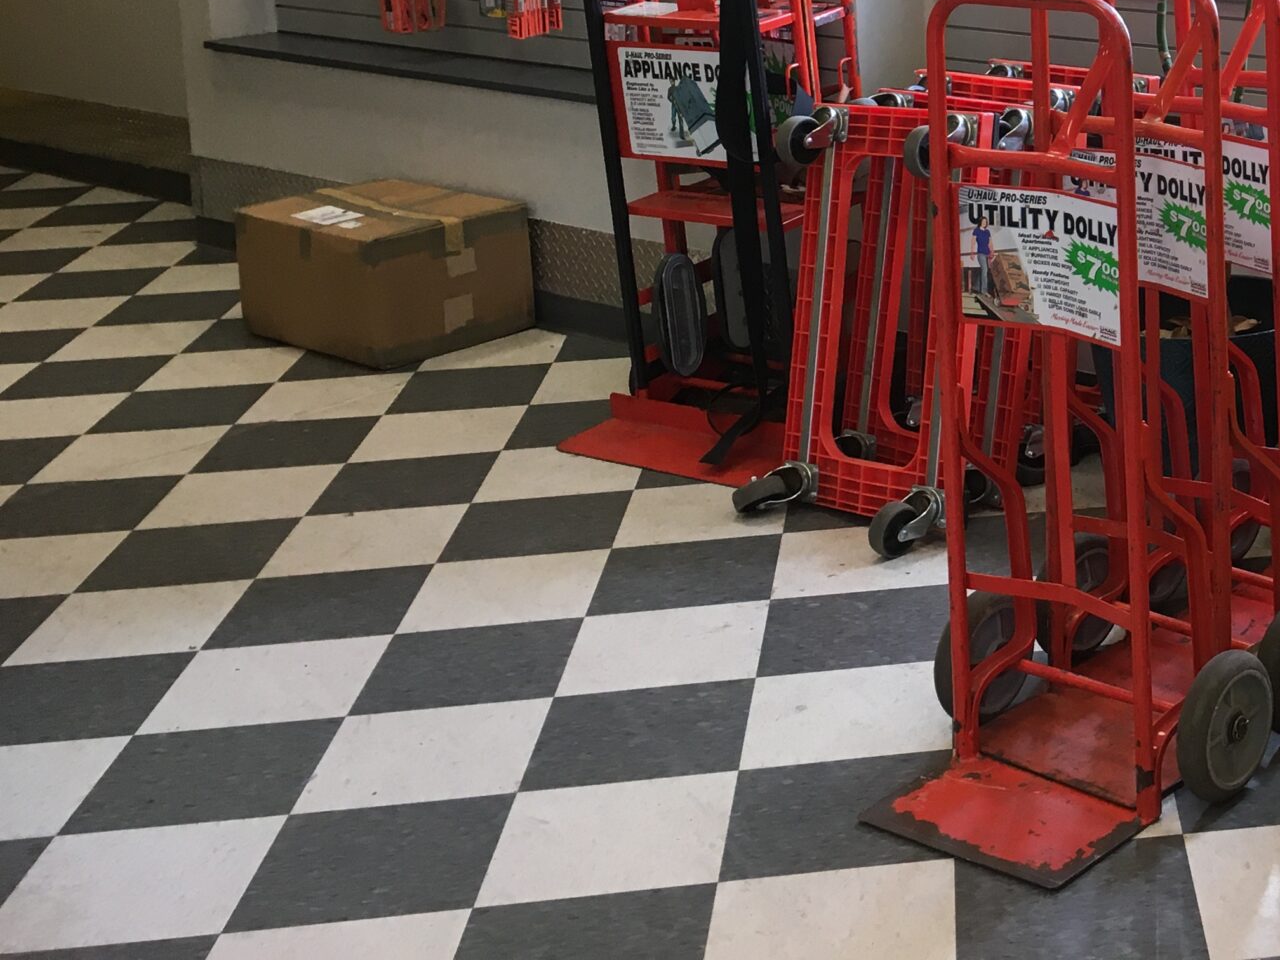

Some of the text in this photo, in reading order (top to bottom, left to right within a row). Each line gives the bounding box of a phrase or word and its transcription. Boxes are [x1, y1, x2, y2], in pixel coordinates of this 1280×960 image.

[625, 51, 643, 60] U-HAUL
[624, 60, 702, 82] APPLIANCE
[1222, 156, 1269, 185] DOLLY
[967, 189, 1047, 205] U-HAUL PRO-SERIES
[1157, 174, 1206, 206] DOLLY
[968, 203, 1117, 247] UTILITY DOLLY
